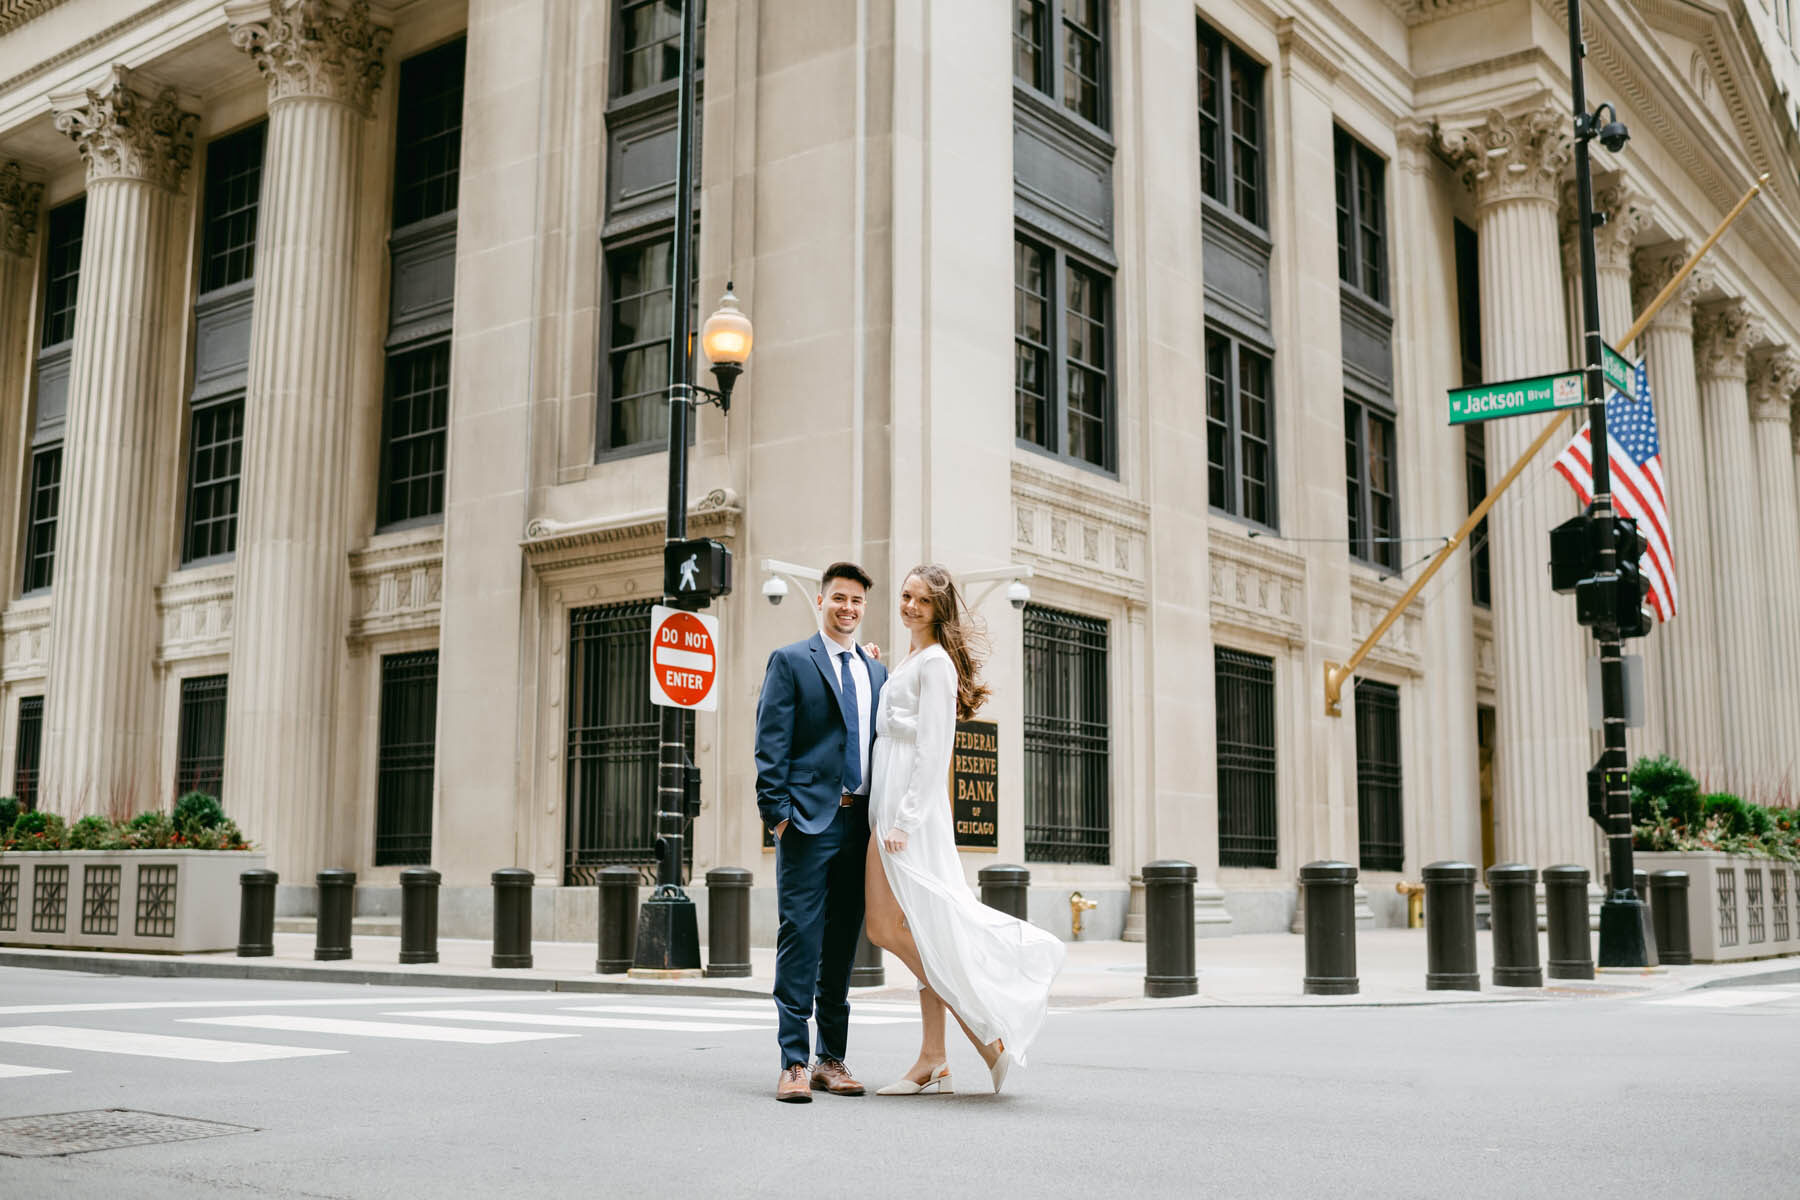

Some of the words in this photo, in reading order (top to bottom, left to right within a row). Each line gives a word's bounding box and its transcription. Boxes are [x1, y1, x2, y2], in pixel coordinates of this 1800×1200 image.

[1452, 400, 1461, 411] W
[1463, 390, 1524, 414] Jackson
[1527, 388, 1550, 401] Blvd
[662, 627, 678, 644] DO
[685, 631, 708, 649] NOT
[666, 670, 703, 690] ENTER
[955, 731, 997, 752] FEDERAL
[955, 754, 997, 775] RESERVE
[958, 778, 995, 802] BANK
[972, 807, 981, 816] OF
[957, 820, 994, 835] CHICAGO
